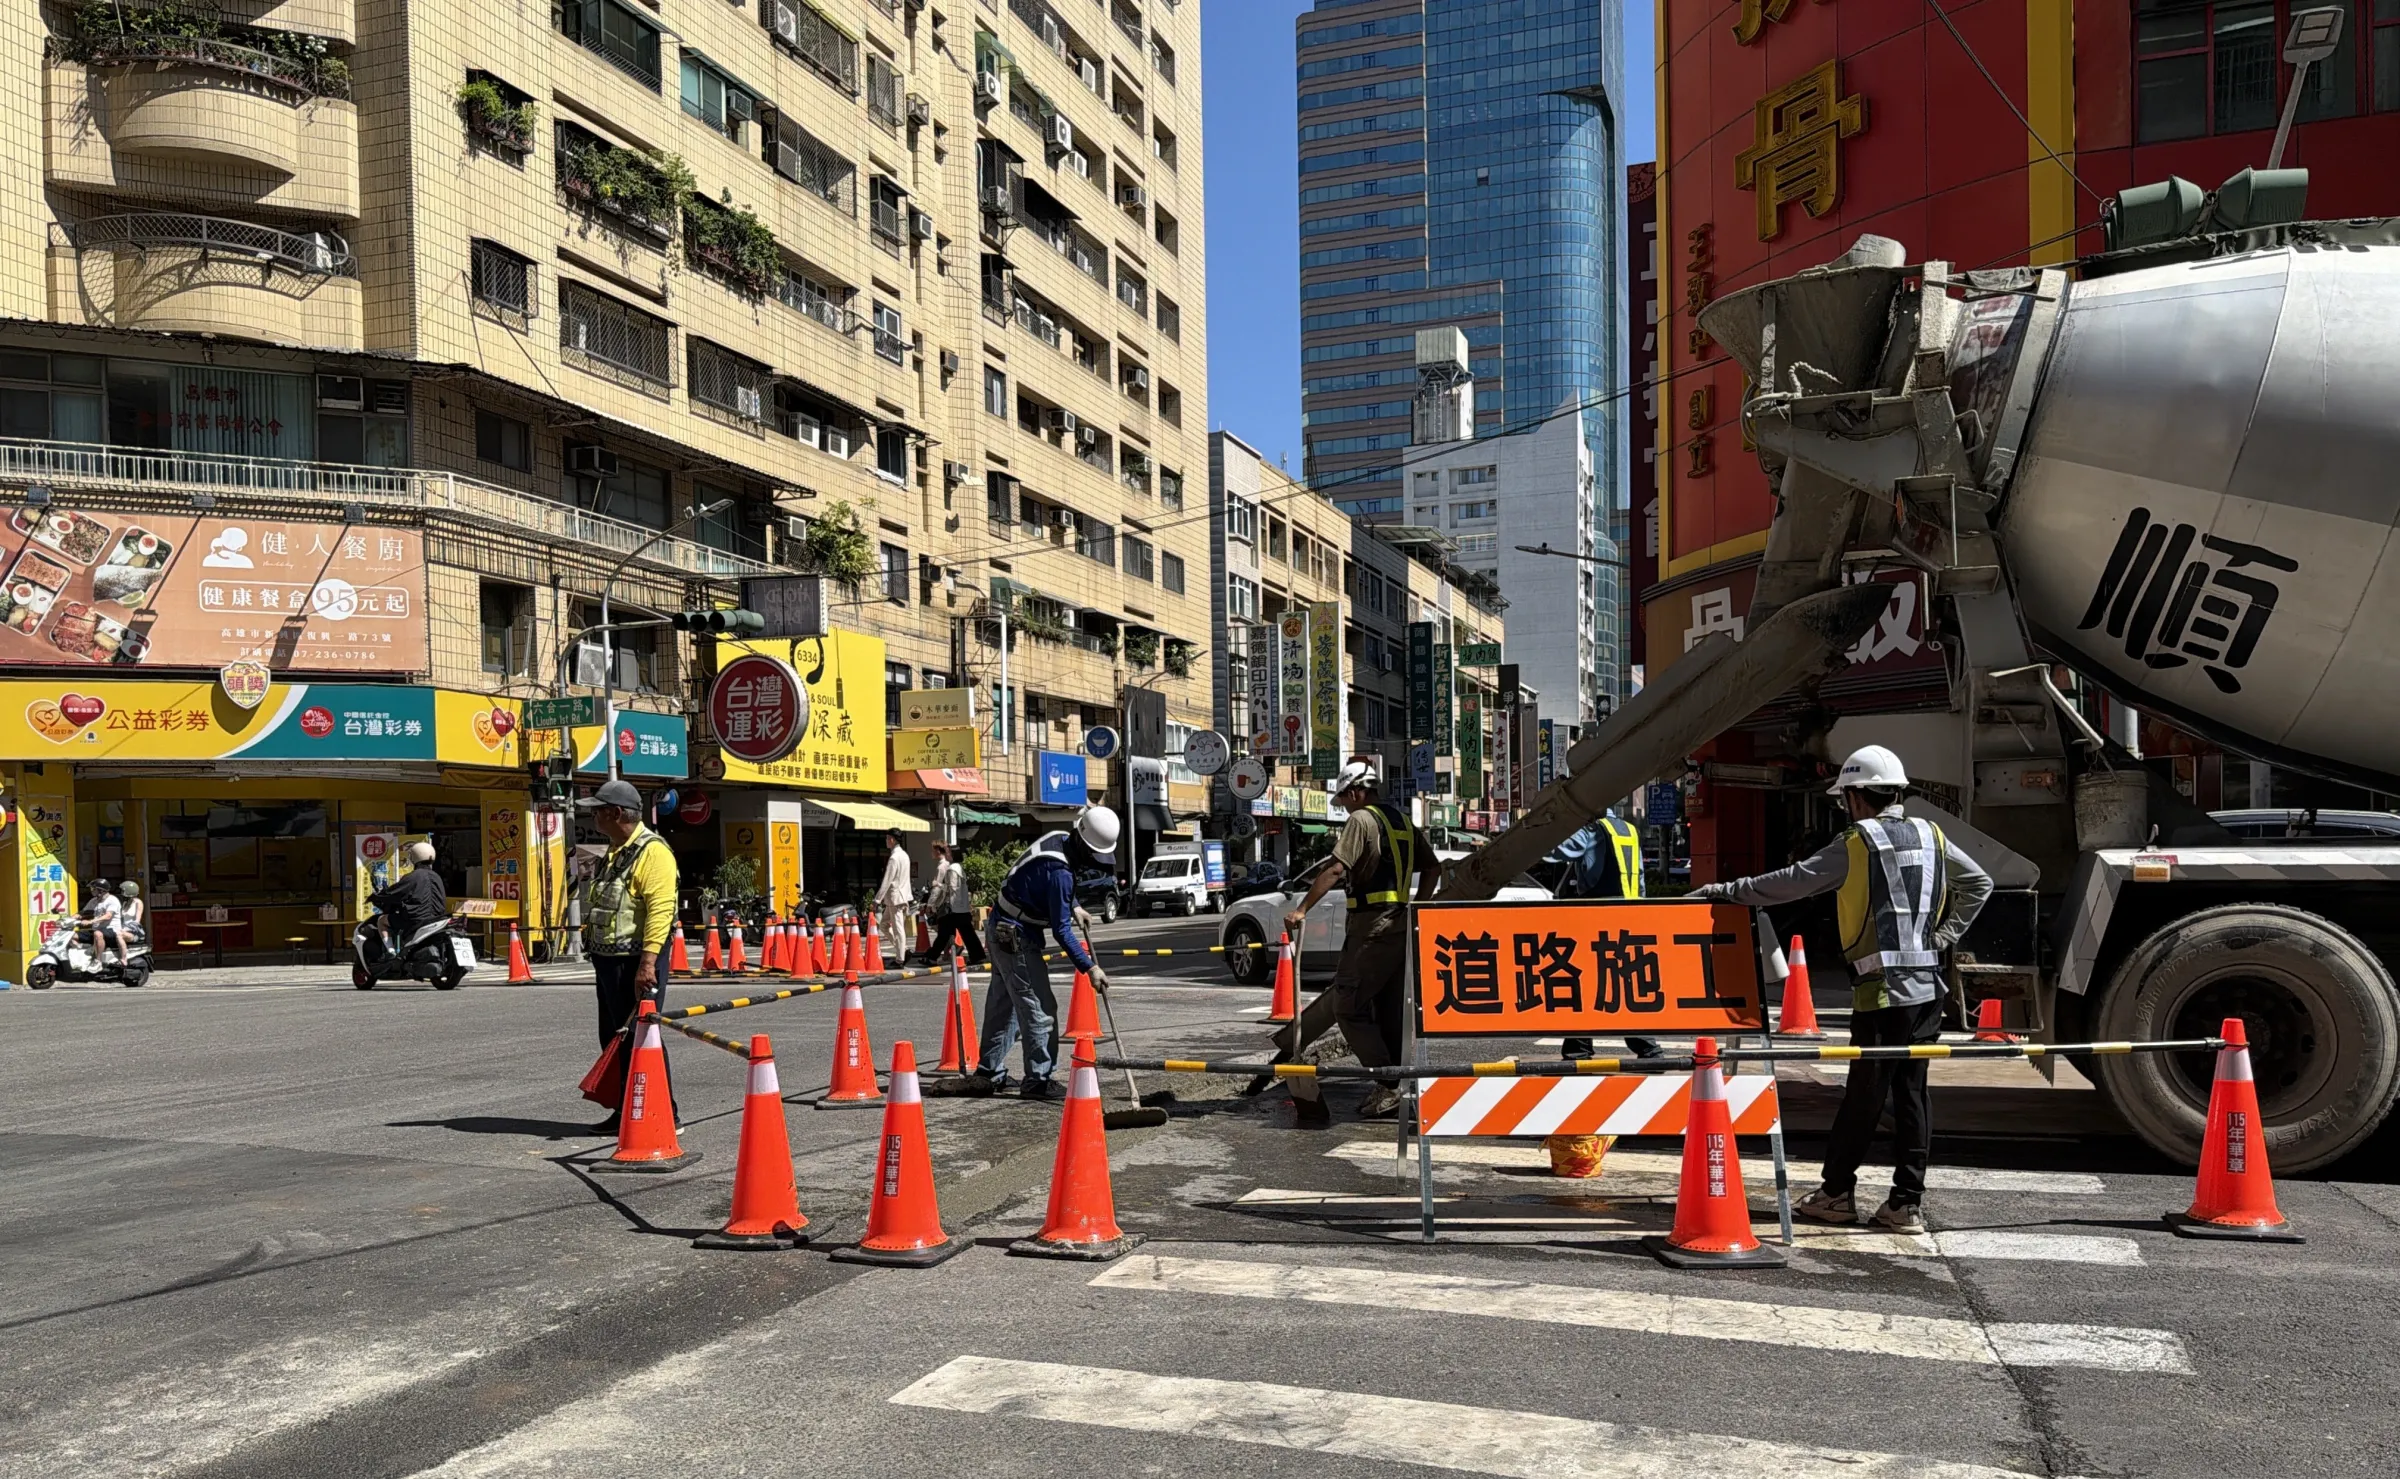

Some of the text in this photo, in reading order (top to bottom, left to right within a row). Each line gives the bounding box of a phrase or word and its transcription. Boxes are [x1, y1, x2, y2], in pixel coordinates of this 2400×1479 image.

[202, 585, 406, 614] 健康餐盒95元起
[2076, 506, 2299, 694] 順
[293, 650, 376, 661] 07-236-0786
[797, 649, 818, 666] 6334
[1283, 639, 1304, 682] 清境
[227, 675, 264, 692] 頭獎
[726, 673, 784, 708] 台灣
[533, 699, 584, 715] 六合一路
[817, 694, 837, 707] SOUL
[106, 708, 210, 732] 公益彩券
[343, 719, 423, 737] 台灣彩券
[724, 709, 785, 743] 運彩
[812, 709, 855, 748] 深藏
[640, 741, 679, 757] 台灣彩券
[1462, 716, 1480, 774] 燒肉飯
[1650, 786, 1661, 799] P
[489, 811, 519, 824] 威力彩
[31, 865, 63, 882] 上看
[493, 858, 518, 876] 上看
[1433, 928, 1748, 1016] 道路施工
